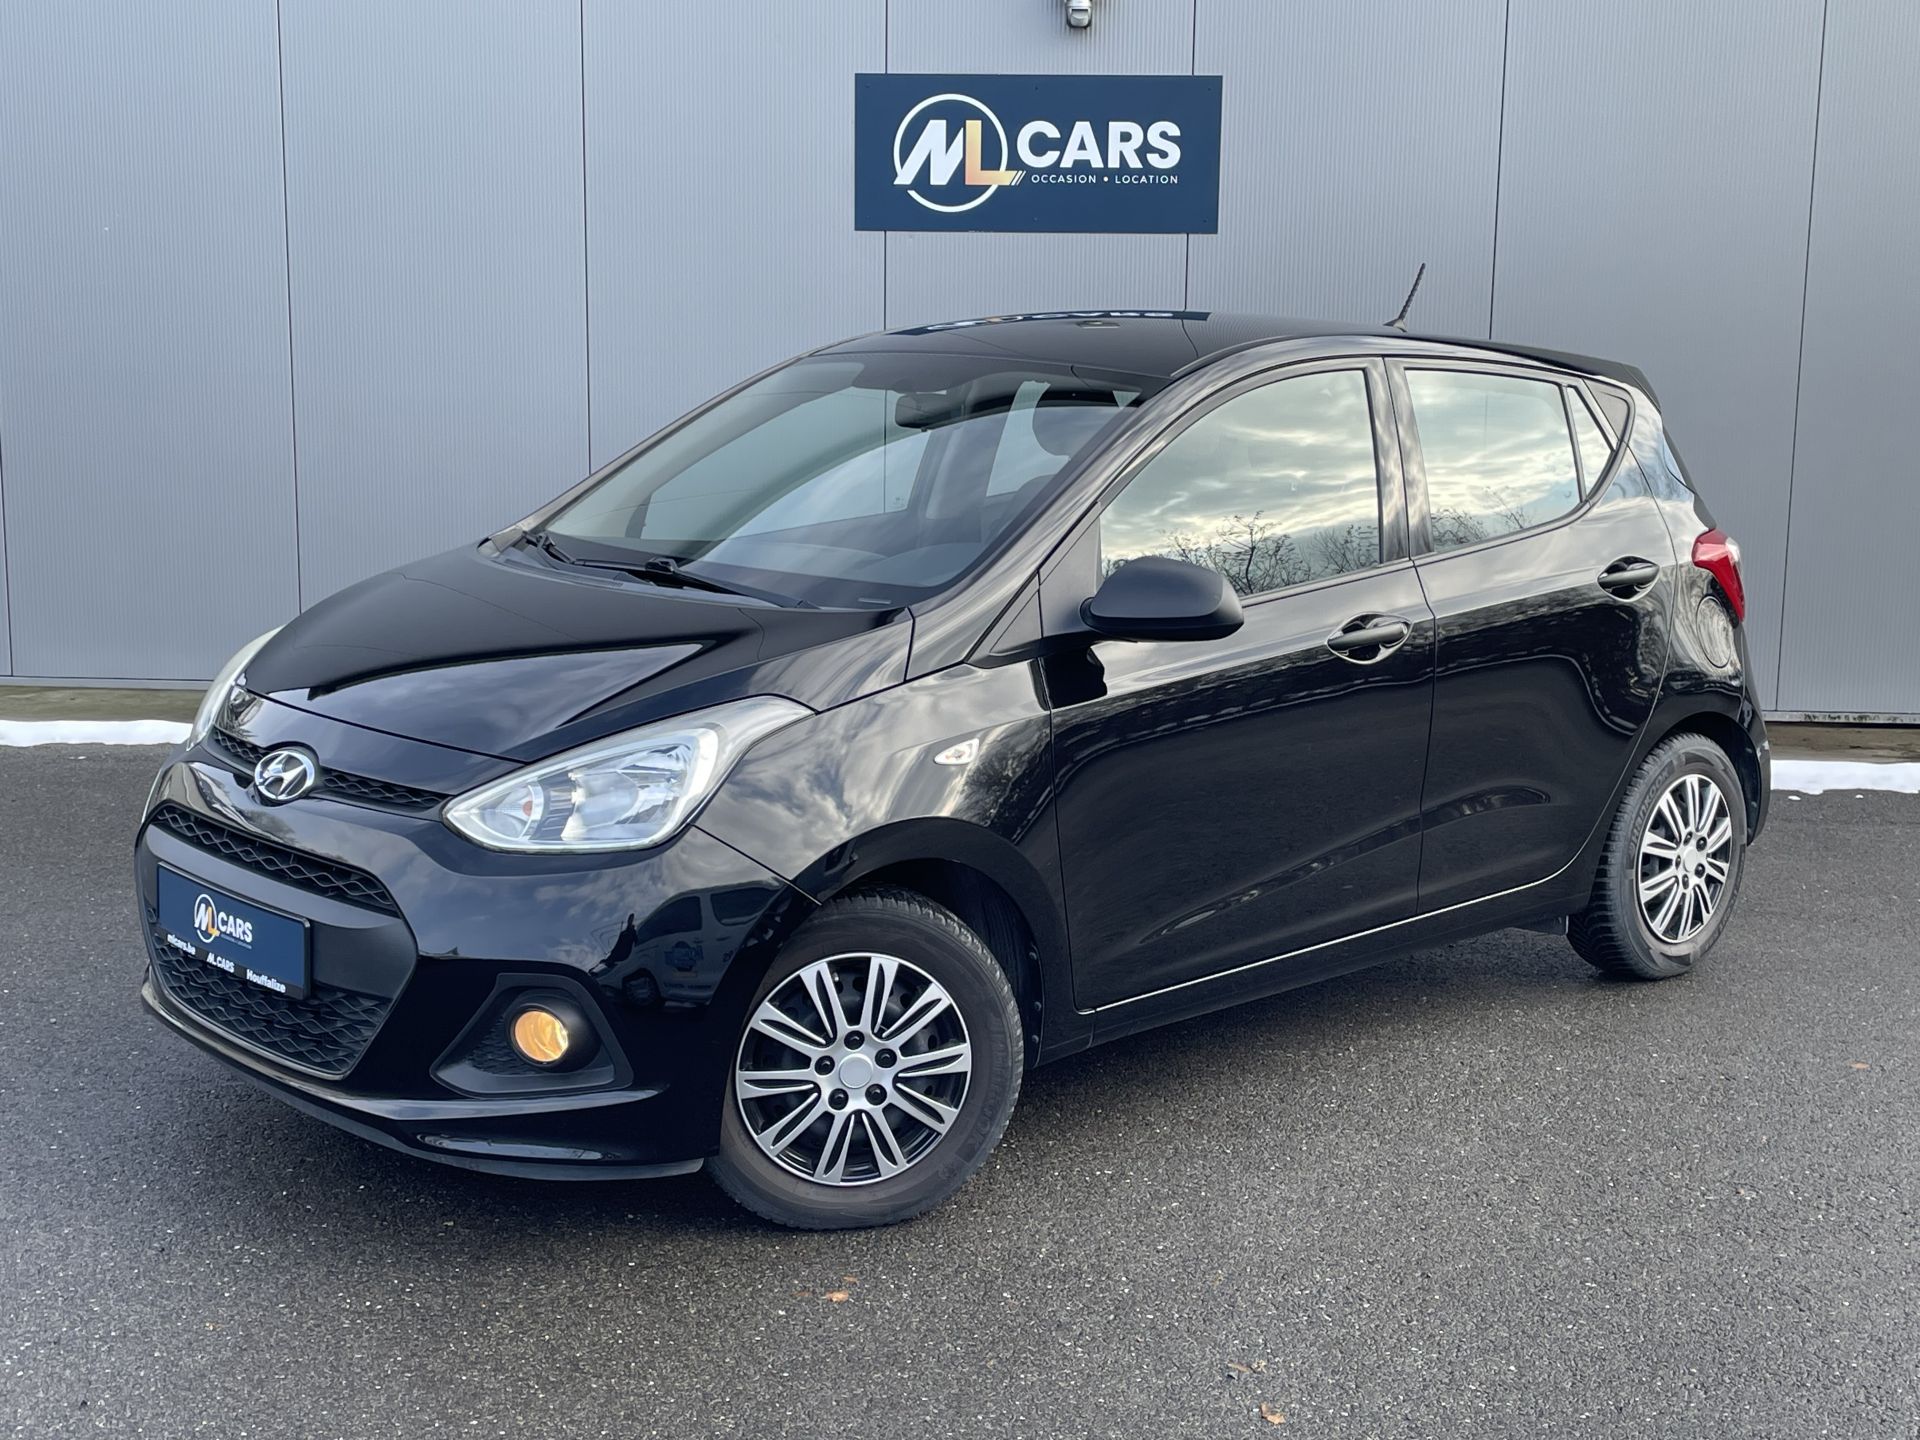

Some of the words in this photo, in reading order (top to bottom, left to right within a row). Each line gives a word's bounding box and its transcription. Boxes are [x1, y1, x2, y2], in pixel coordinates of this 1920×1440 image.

[893, 119, 1027, 186] ML
[1016, 120, 1182, 169] CARS
[1031, 174, 1097, 185] OCCASION
[1115, 174, 1179, 185] LOCATION
[217, 911, 253, 943] CARS
[246, 968, 286, 993] Houffalize
